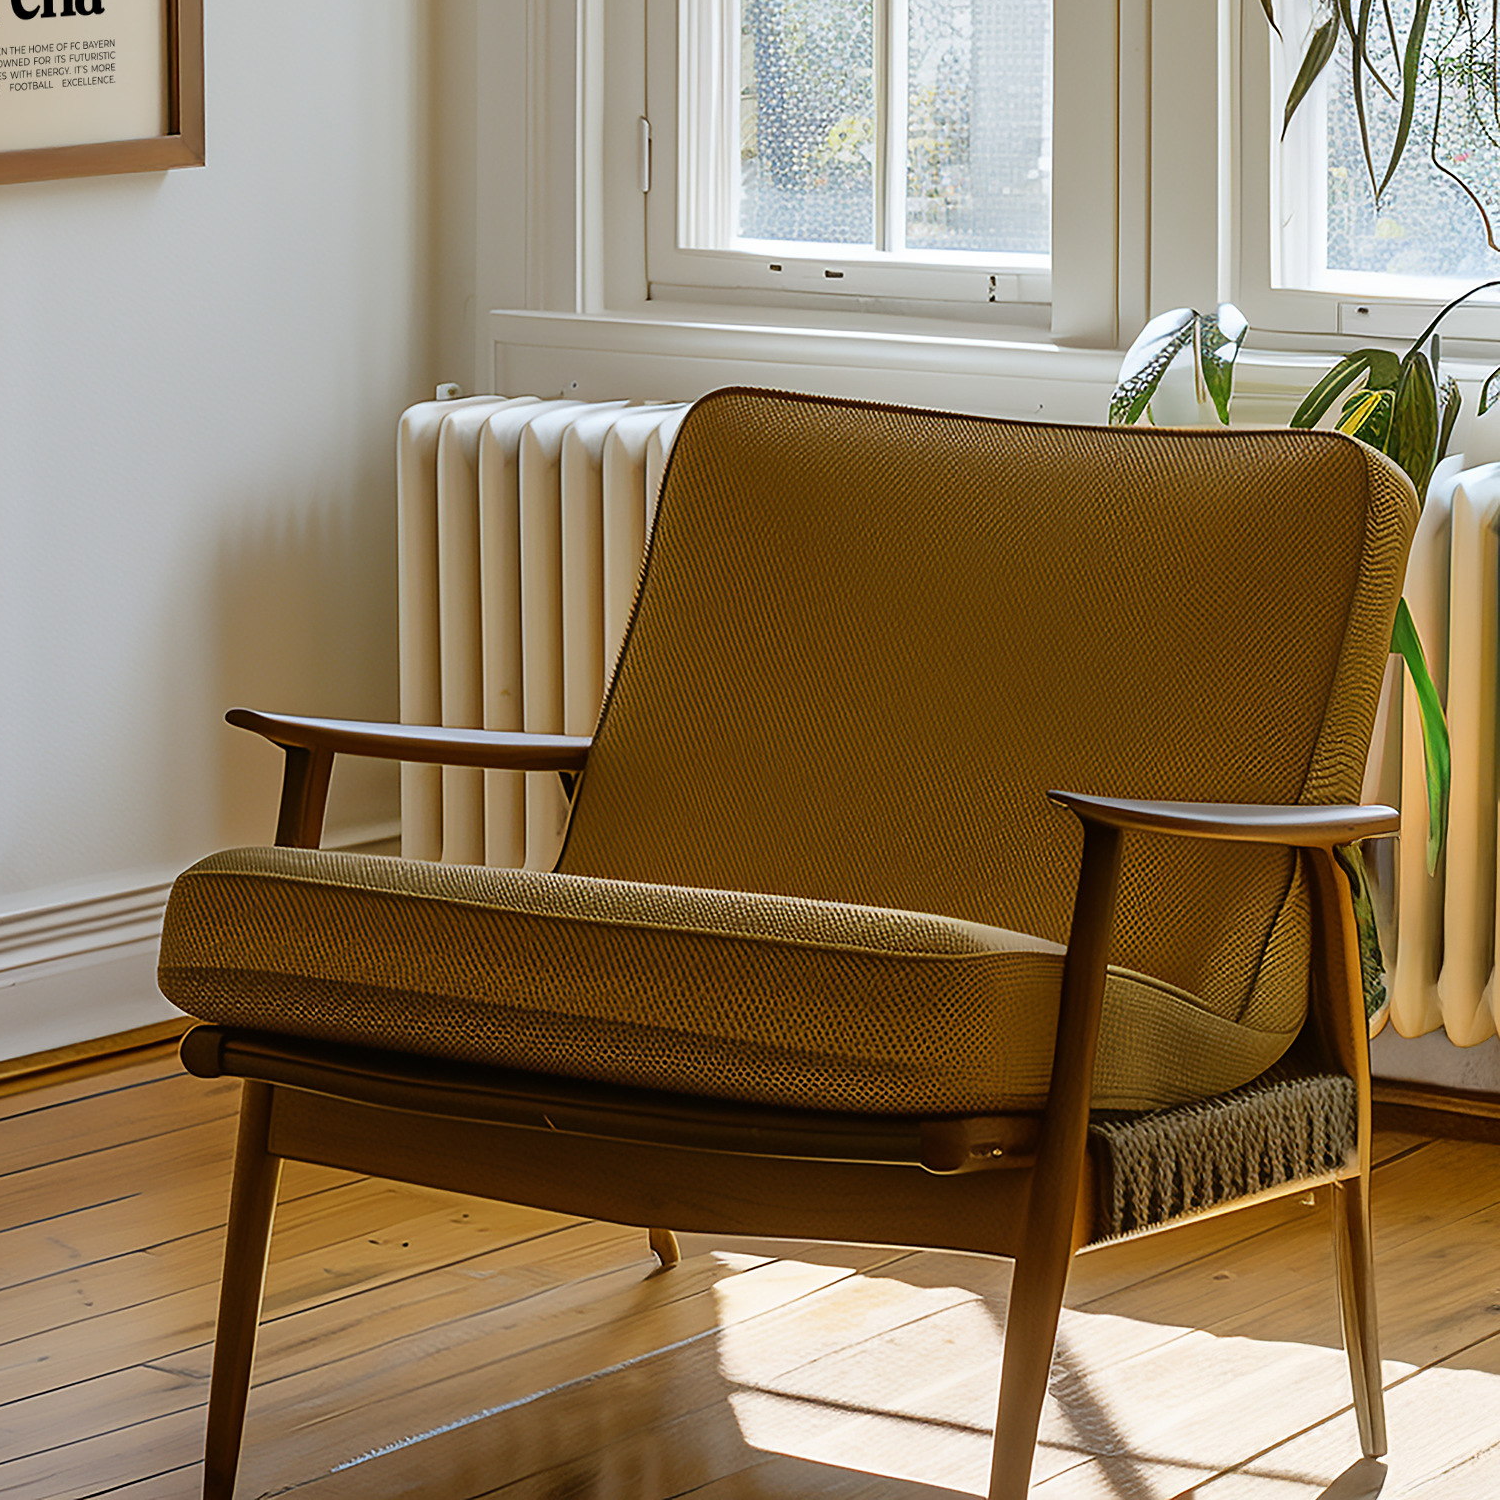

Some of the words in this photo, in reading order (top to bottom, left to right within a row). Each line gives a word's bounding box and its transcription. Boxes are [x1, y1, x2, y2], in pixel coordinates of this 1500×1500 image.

[8, 45, 27, 55] THE
[28, 43, 55, 54] HOME
[55, 42, 69, 52] OF
[69, 41, 81, 51] FC
[82, 38, 116, 50] BAYERN
[33, 55, 52, 66] FOR
[54, 54, 67, 64] ITS
[68, 50, 117, 63] FUTURISTIC
[9, 69, 33, 80] WITH
[35, 66, 72, 78] ENERGY.
[90, 62, 116, 73] MORE
[9, 80, 54, 92] FOOTBALL
[61, 74, 116, 88] EXCELLENCE.
